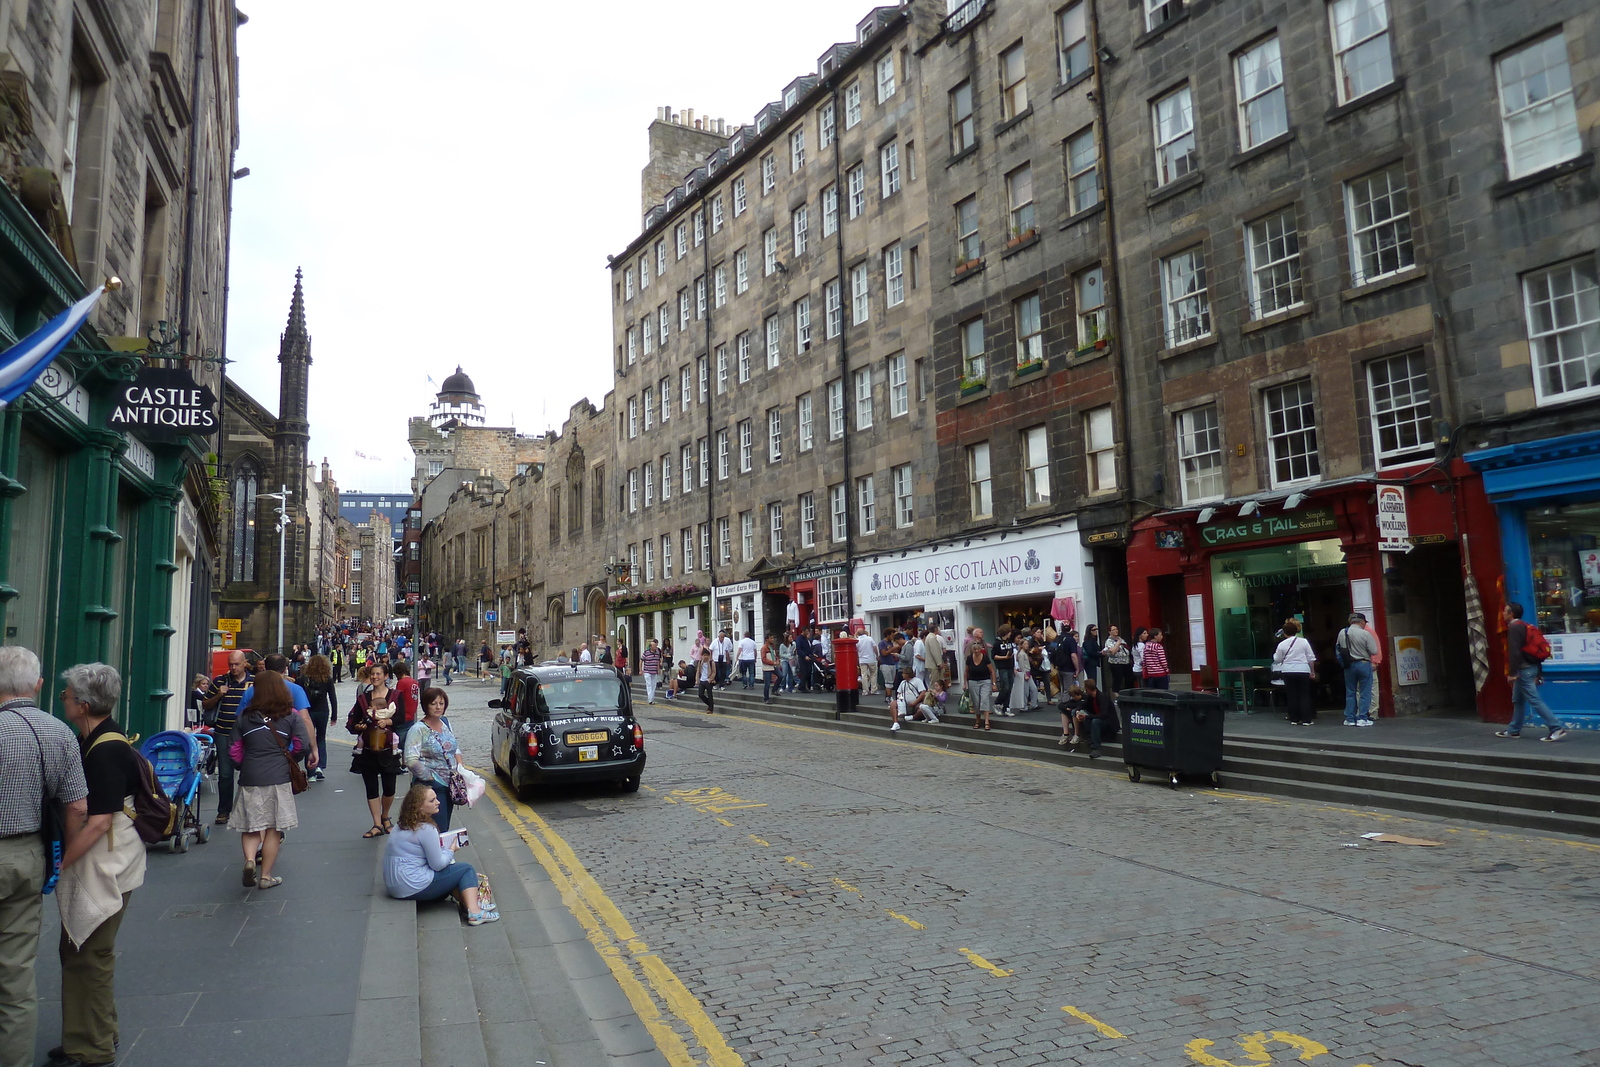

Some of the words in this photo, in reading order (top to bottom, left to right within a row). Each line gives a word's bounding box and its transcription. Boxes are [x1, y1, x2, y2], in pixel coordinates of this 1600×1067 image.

[125, 386, 202, 406] CASTLE
[111, 405, 214, 427] ANTIQUES
[1380, 501, 1405, 513] CASHMERE
[1305, 510, 1326, 520] Simple
[1202, 525, 1247, 544] CRAG
[1252, 523, 1263, 534] &
[1263, 517, 1298, 536] TAIL
[1299, 520, 1321, 529] Scottish
[1321, 518, 1334, 526] Fare
[1381, 521, 1407, 530] WOOLLENS
[827, 566, 842, 575] SHOP
[884, 570, 920, 590] HOUSE
[924, 567, 940, 584] OF
[944, 555, 1021, 582] SCOTLAND
[717, 586, 725, 595] The
[725, 584, 736, 594] Court
[748, 580, 759, 591] Shop
[1218, 573, 1293, 591] RESTAURANT
[870, 593, 888, 603] Scottish
[888, 591, 899, 602] gifts
[905, 589, 930, 599] Cashmere
[937, 586, 948, 596] Lyle
[948, 585, 954, 593] &
[955, 583, 969, 593] Scott
[977, 580, 997, 590] Tartan
[997, 578, 1011, 590] gifts
[1012, 578, 1025, 586] from
[1024, 576, 1041, 585] £1.99
[1580, 639, 1587, 653] J
[1407, 670, 1420, 681] £10
[551, 719, 572, 727] HEART
[1130, 711, 1164, 727] shanks.
[570, 733, 589, 742] SN06
[590, 732, 605, 740] GGX
